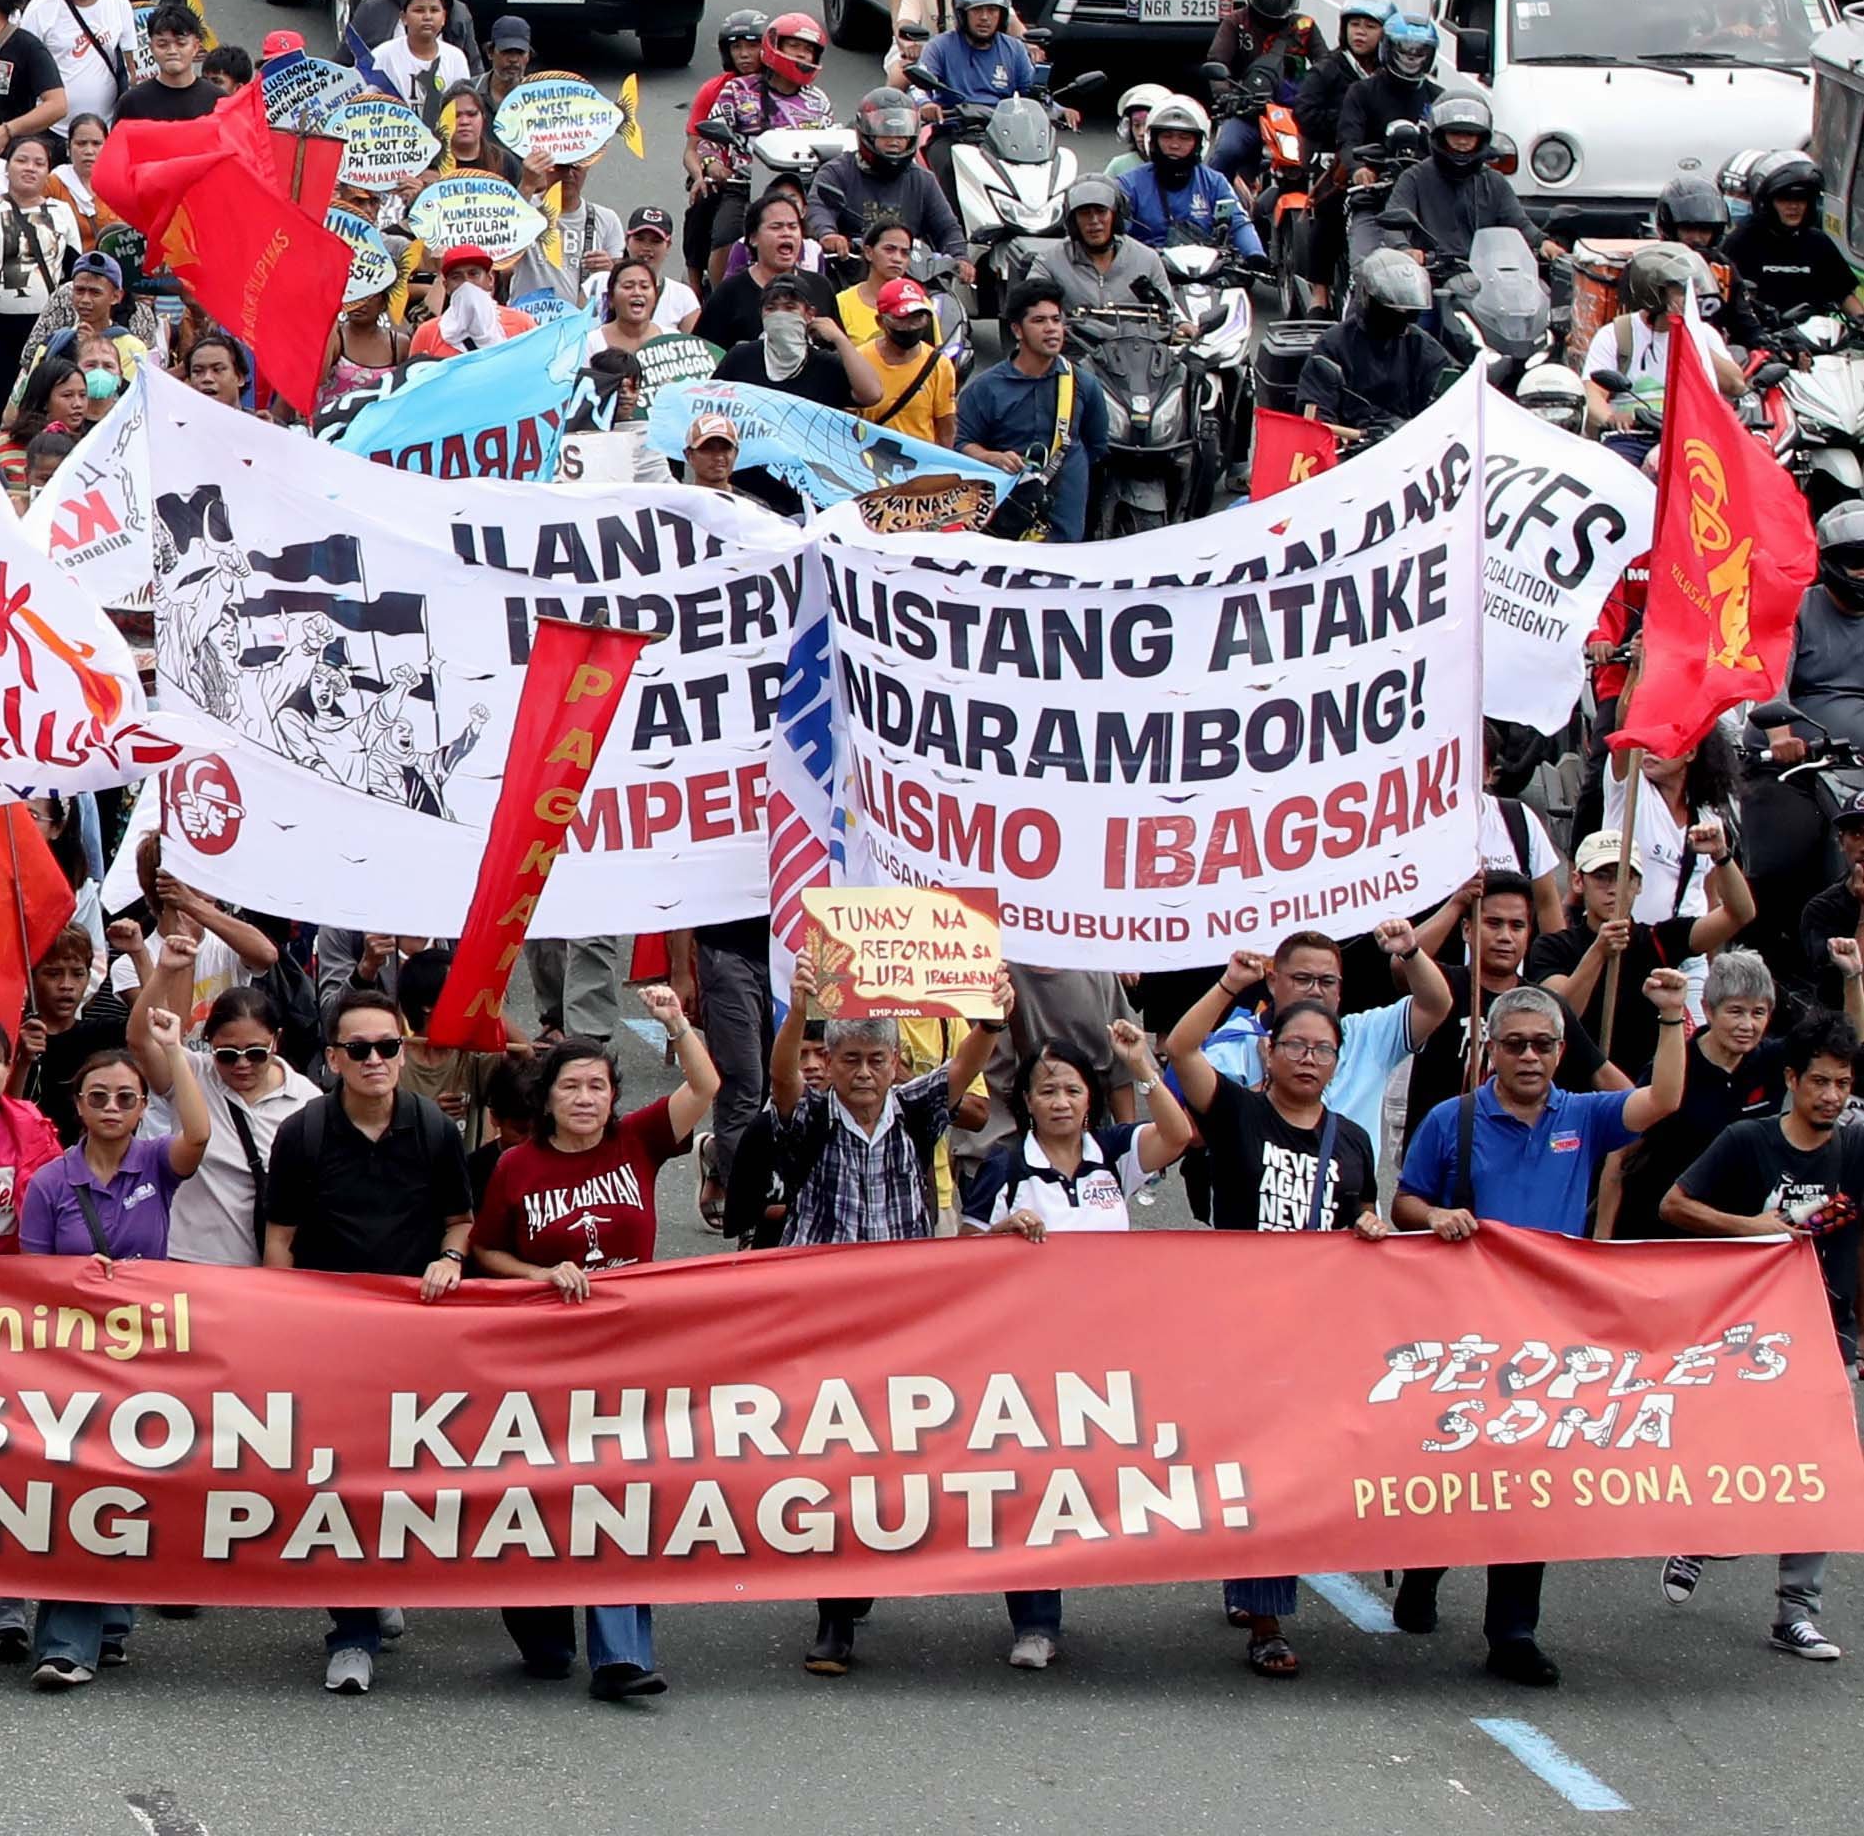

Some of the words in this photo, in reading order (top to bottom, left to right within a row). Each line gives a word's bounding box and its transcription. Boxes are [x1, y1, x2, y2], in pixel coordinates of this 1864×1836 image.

[1144, 0, 1170, 16] NGR
[1181, 0, 1217, 16] 5215
[524, 85, 595, 106] DEMILITARIZE
[345, 104, 383, 119] CHINA
[389, 105, 413, 121] OUT
[536, 100, 572, 116] WEST
[368, 115, 385, 125] OF
[527, 113, 584, 129] PHILIPPINE
[588, 109, 610, 126] SEA!
[350, 128, 366, 141] PH
[369, 123, 420, 140] WATERS,
[373, 139, 399, 152] OUT
[401, 137, 417, 152] OF
[347, 155, 365, 168] PH
[366, 146, 429, 166] TERRITORY!
[438, 180, 515, 200] REKLAMASYON
[467, 195, 482, 207] AT
[443, 204, 522, 222] KUMBERSYON,
[446, 218, 501, 235] TUTULAN
[452, 229, 520, 249] LABANAN!
[1484, 557, 1561, 607] COALITION
[1208, 542, 1449, 675] ATAKE
[631, 675, 729, 754] AT
[1102, 736, 1463, 891] IBAGSAK!
[1206, 904, 1259, 938] NG
[1268, 864, 1420, 930] PILIPINAS
[824, 905, 914, 935] TUNAY
[933, 905, 970, 932] NA
[860, 938, 962, 962] REPORMA
[971, 941, 991, 960] SA
[856, 964, 916, 987] LUPA
[923, 968, 1002, 990] IPAGLABAN
[524, 1163, 642, 1242] MAKABAYAN
[389, 1369, 1180, 1470] KAHIRAPAN,
[1353, 1464, 1553, 1521] PEOPLE'S
[1573, 1465, 1693, 1511] SONA
[1708, 1463, 1827, 1506] 2025
[202, 1460, 1252, 1561] PANANAGUTAN!
